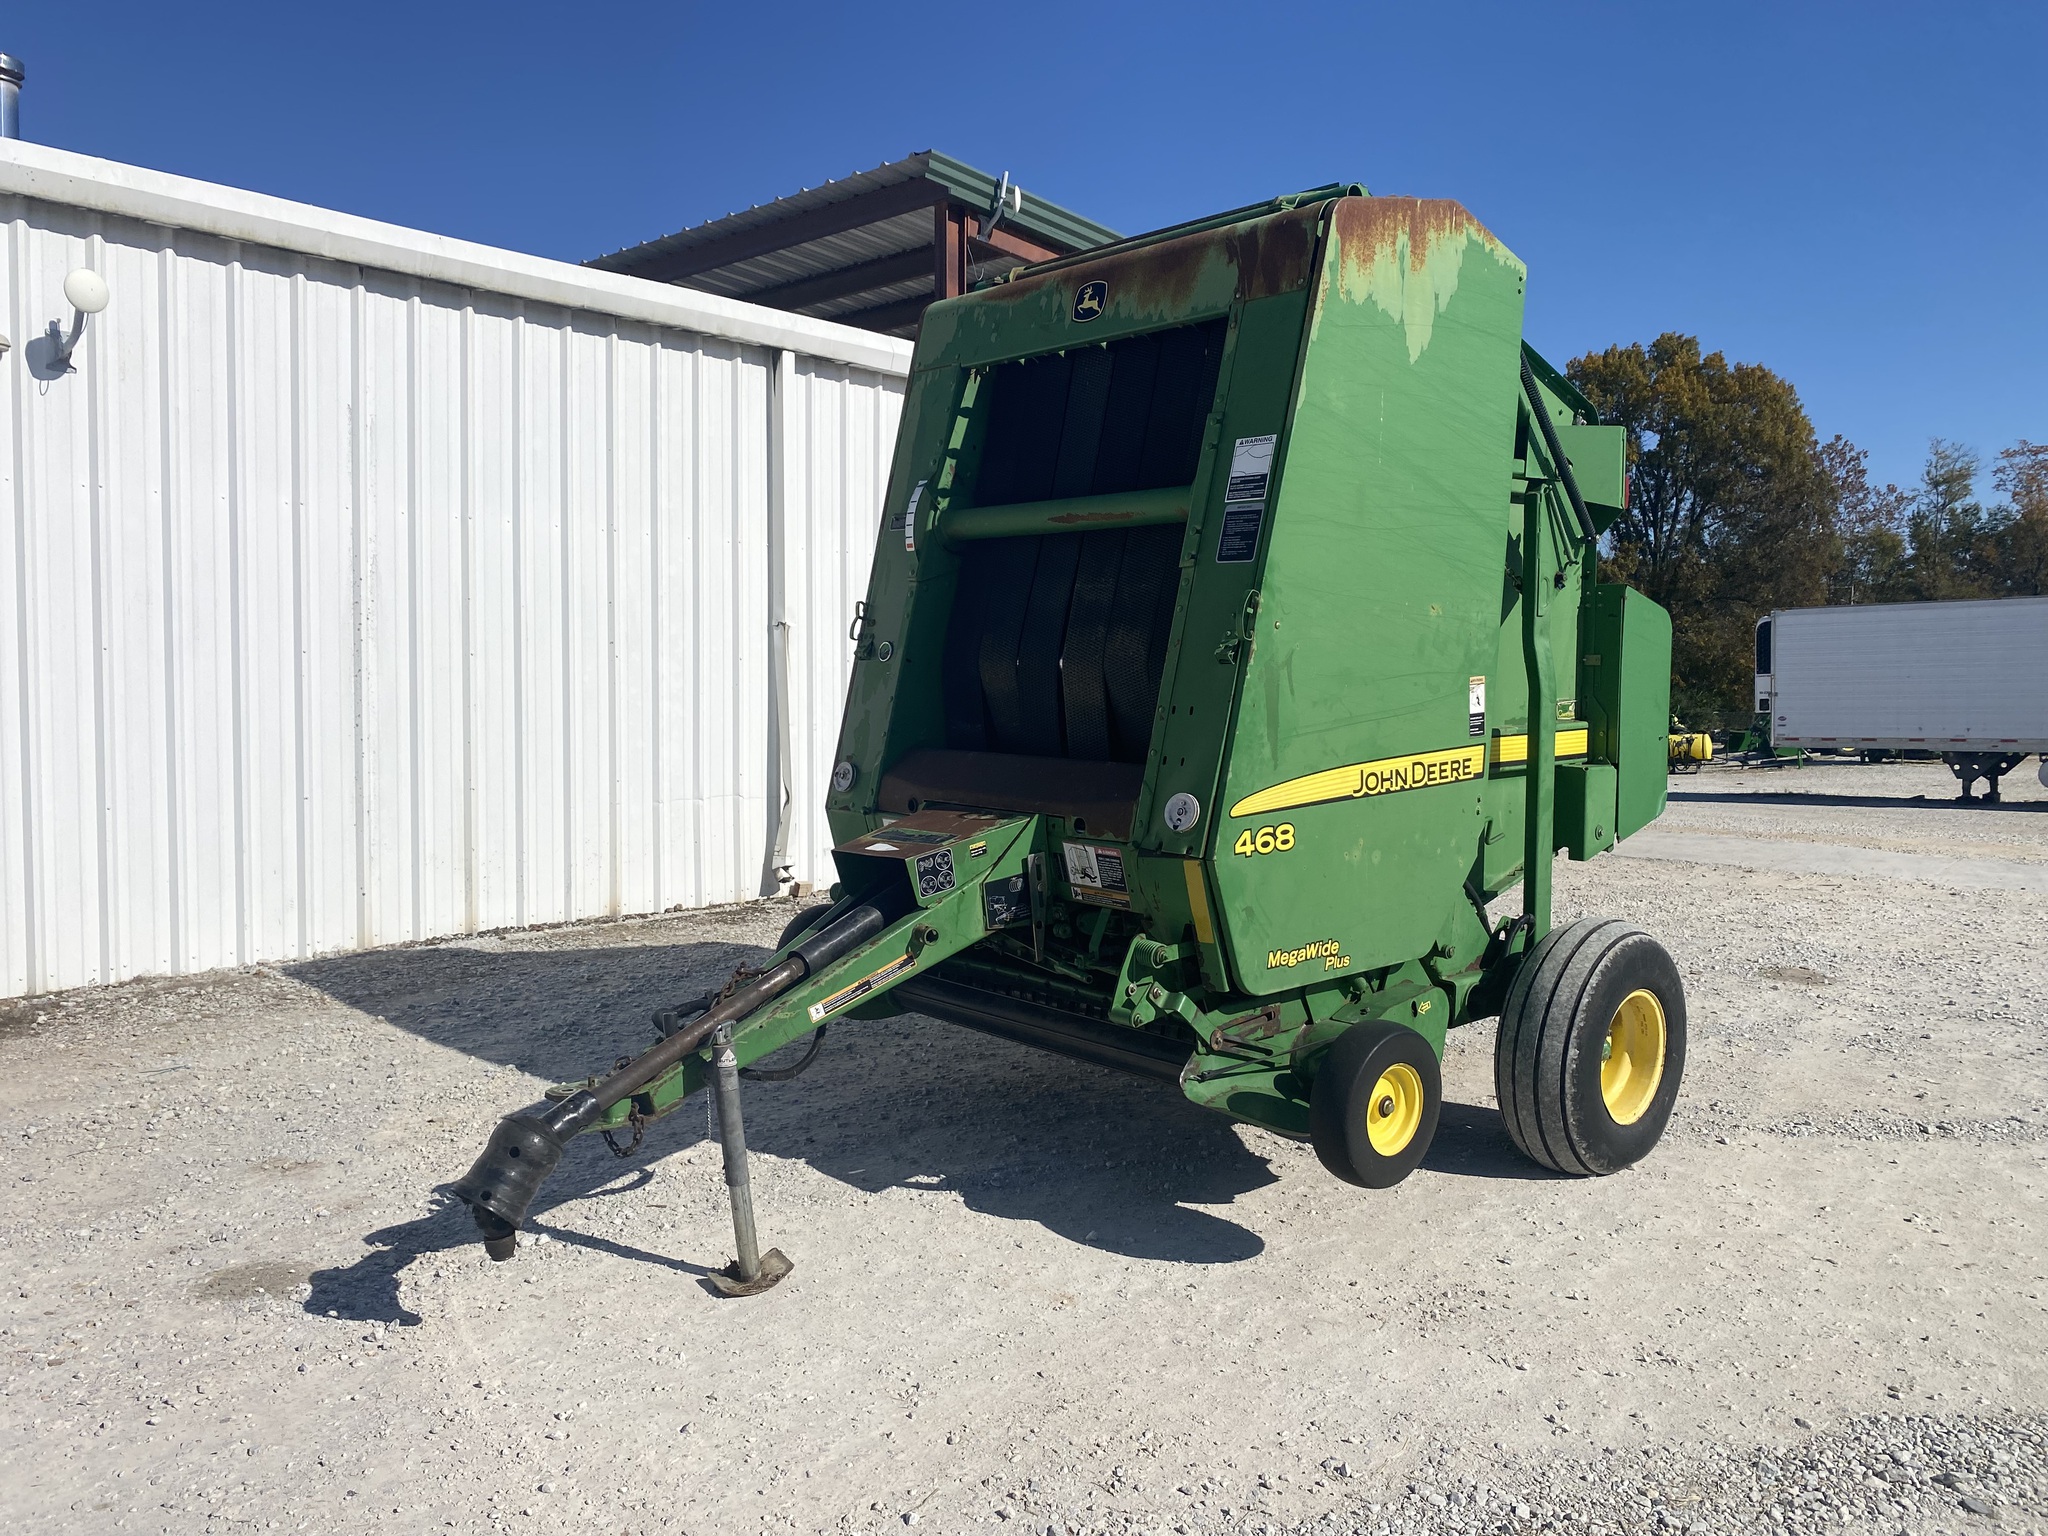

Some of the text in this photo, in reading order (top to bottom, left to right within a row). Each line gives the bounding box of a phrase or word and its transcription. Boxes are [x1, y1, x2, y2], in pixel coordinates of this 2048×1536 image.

[1244, 436, 1273, 445] WARNING
[1353, 758, 1472, 794] JOHN DEERE
[1234, 822, 1295, 858] 468
[1266, 938, 1340, 970] MegaWide
[1324, 955, 1350, 971] Plus
